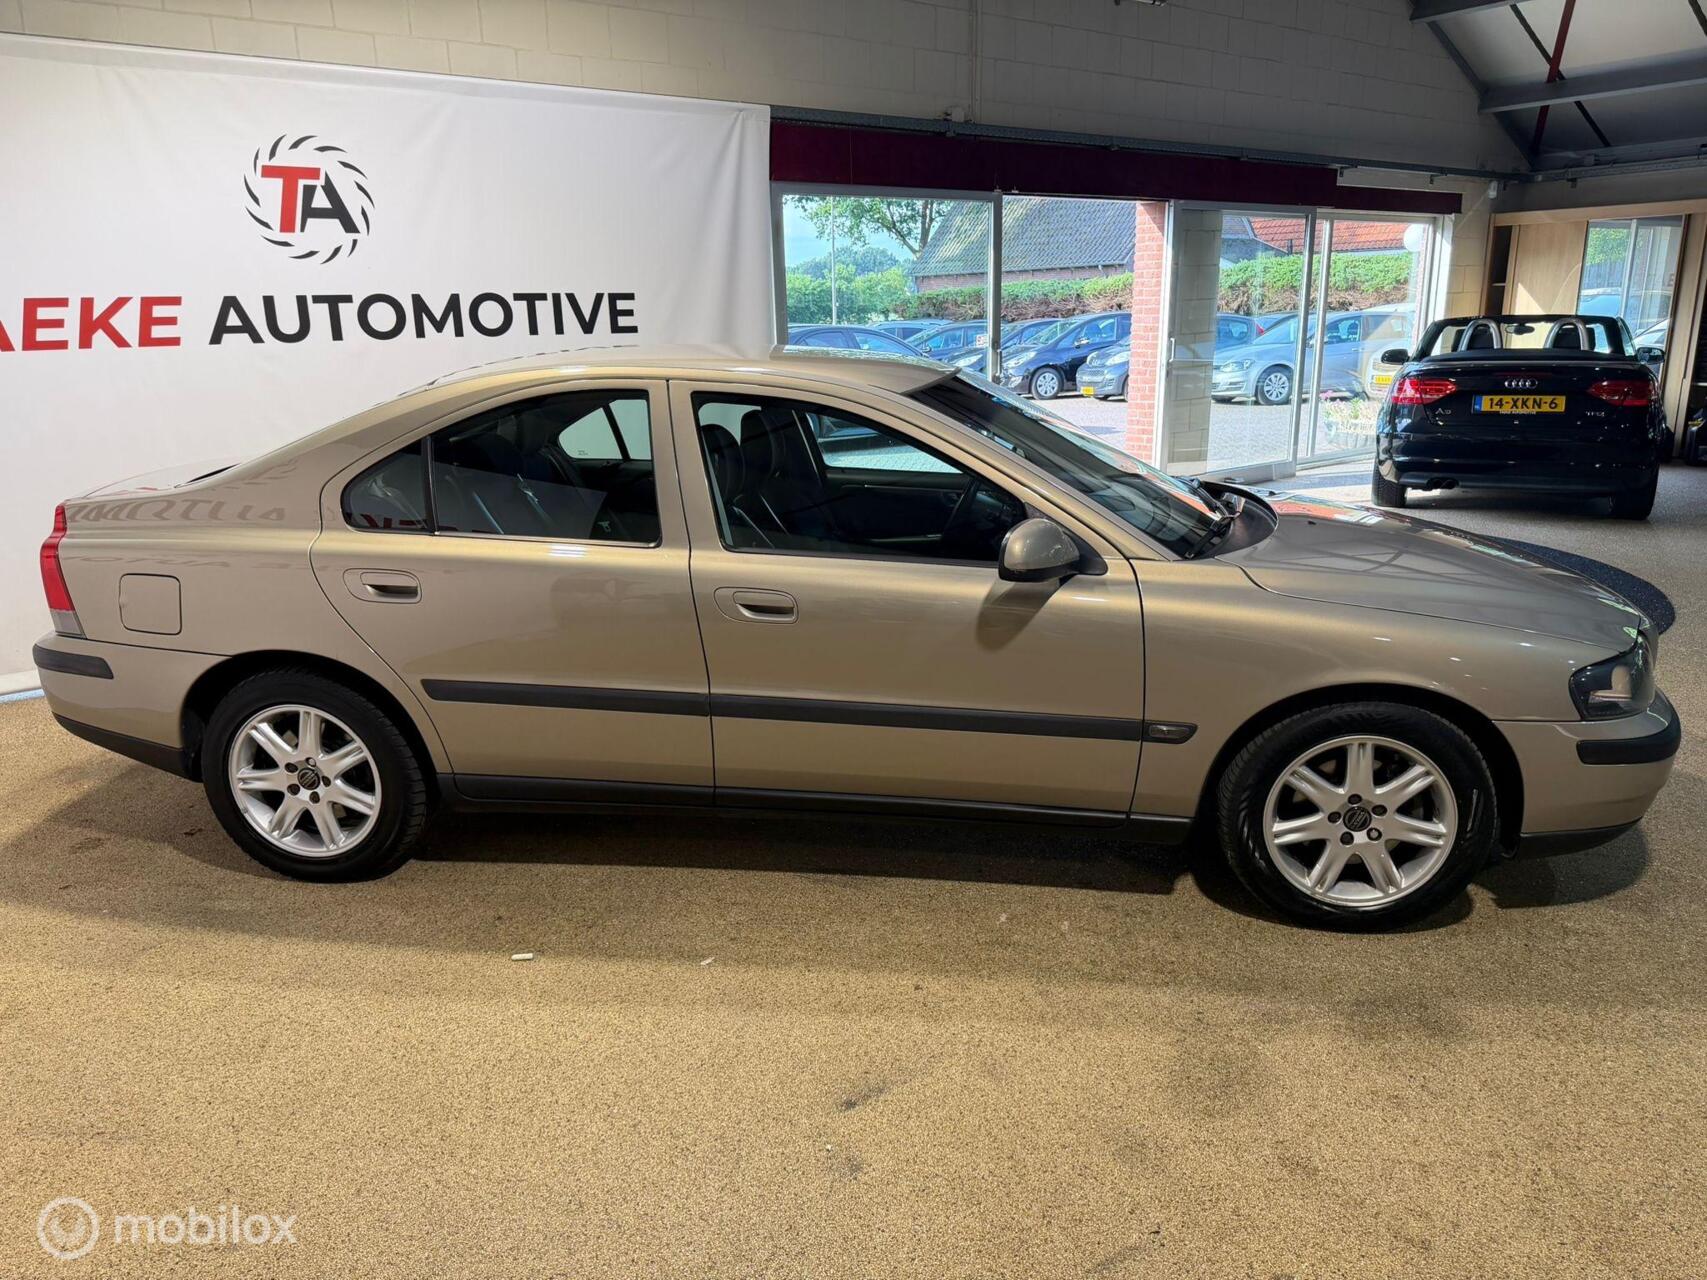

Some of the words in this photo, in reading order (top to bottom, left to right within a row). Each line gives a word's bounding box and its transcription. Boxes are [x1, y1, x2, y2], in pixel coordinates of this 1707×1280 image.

[260, 164, 361, 234] TA
[0, 296, 182, 352] EKE
[208, 292, 639, 345] AUTOMOTIVE
[1489, 397, 1558, 410] 14-XKN-6
